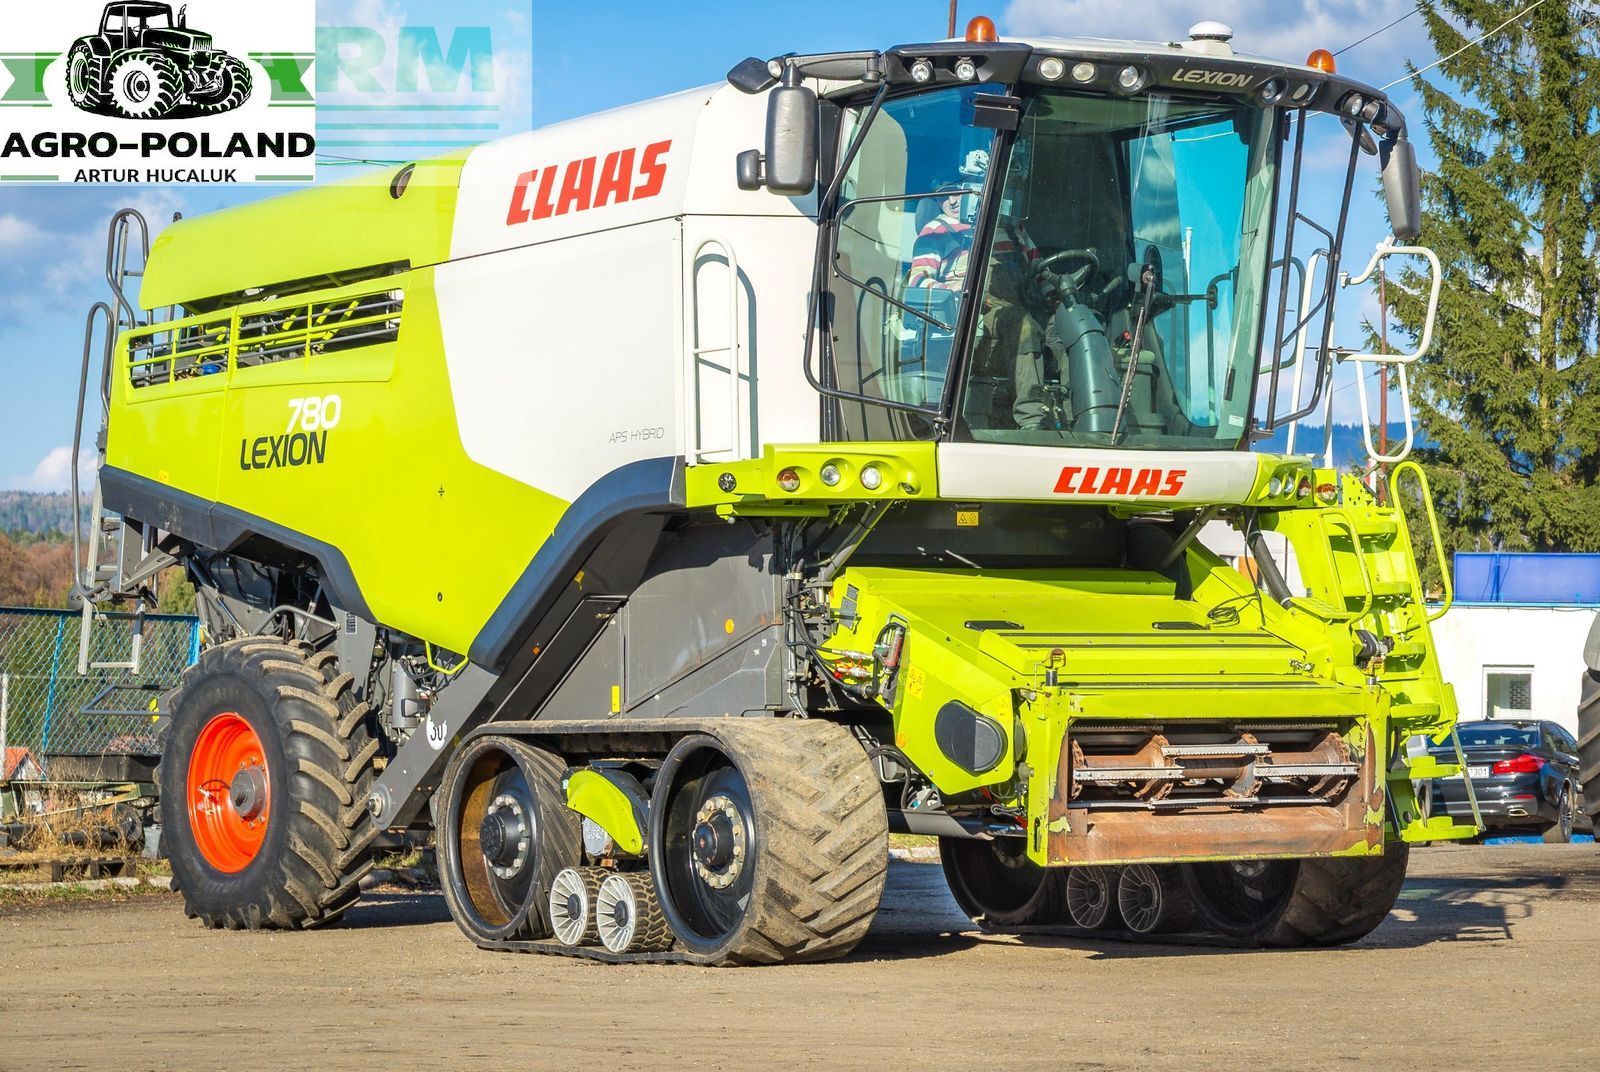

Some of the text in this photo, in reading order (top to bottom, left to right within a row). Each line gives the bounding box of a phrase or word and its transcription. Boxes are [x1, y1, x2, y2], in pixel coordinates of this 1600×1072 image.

[1171, 68, 1253, 87] LEXION
[506, 139, 672, 225] CLAAS
[286, 394, 341, 432] 780
[240, 430, 327, 470] LEXION
[608, 427, 664, 443] APS HYBRID
[1053, 466, 1187, 496] CLAAS
